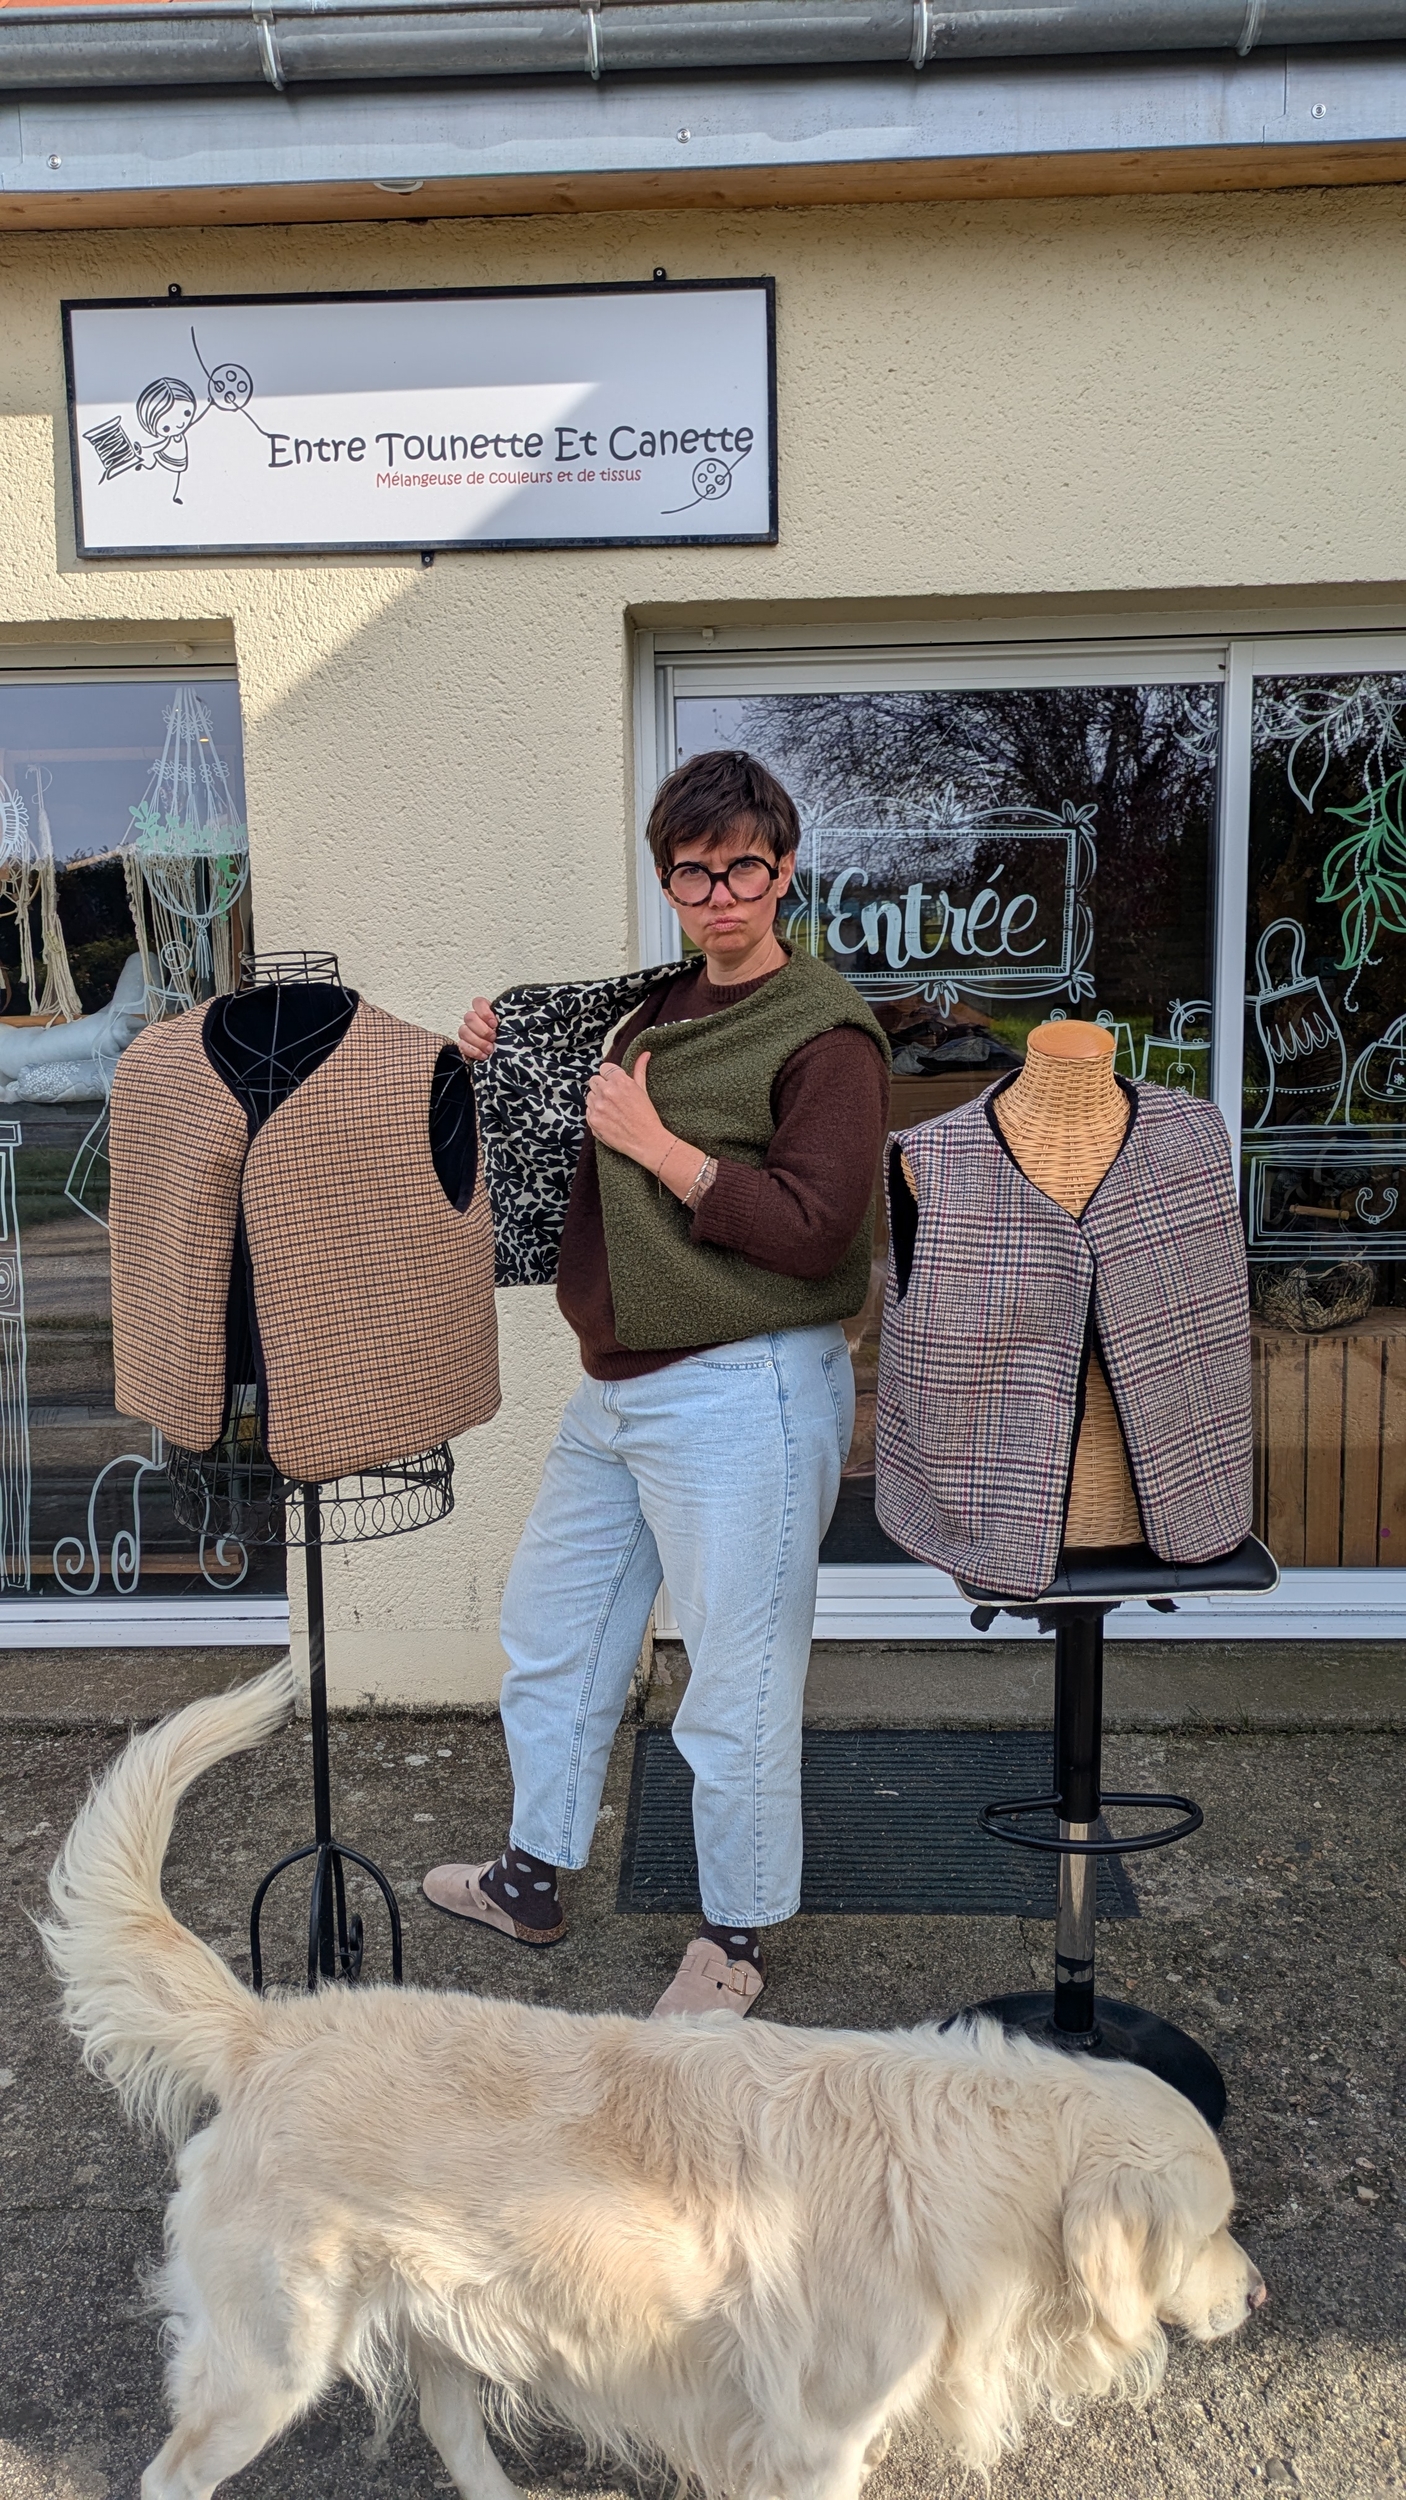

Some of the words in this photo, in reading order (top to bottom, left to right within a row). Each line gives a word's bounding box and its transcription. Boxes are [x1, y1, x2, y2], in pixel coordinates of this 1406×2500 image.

[267, 434, 366, 467] Entre
[375, 433, 544, 467] Tounette
[554, 427, 598, 462] Et
[609, 426, 754, 461] Canette
[376, 471, 463, 489] Mélangeuse
[466, 471, 485, 485] de
[488, 471, 553, 485] couleurs
[557, 471, 573, 483] et
[577, 469, 596, 482] de
[599, 469, 642, 482] tissus
[827, 864, 1047, 968] Entrée
